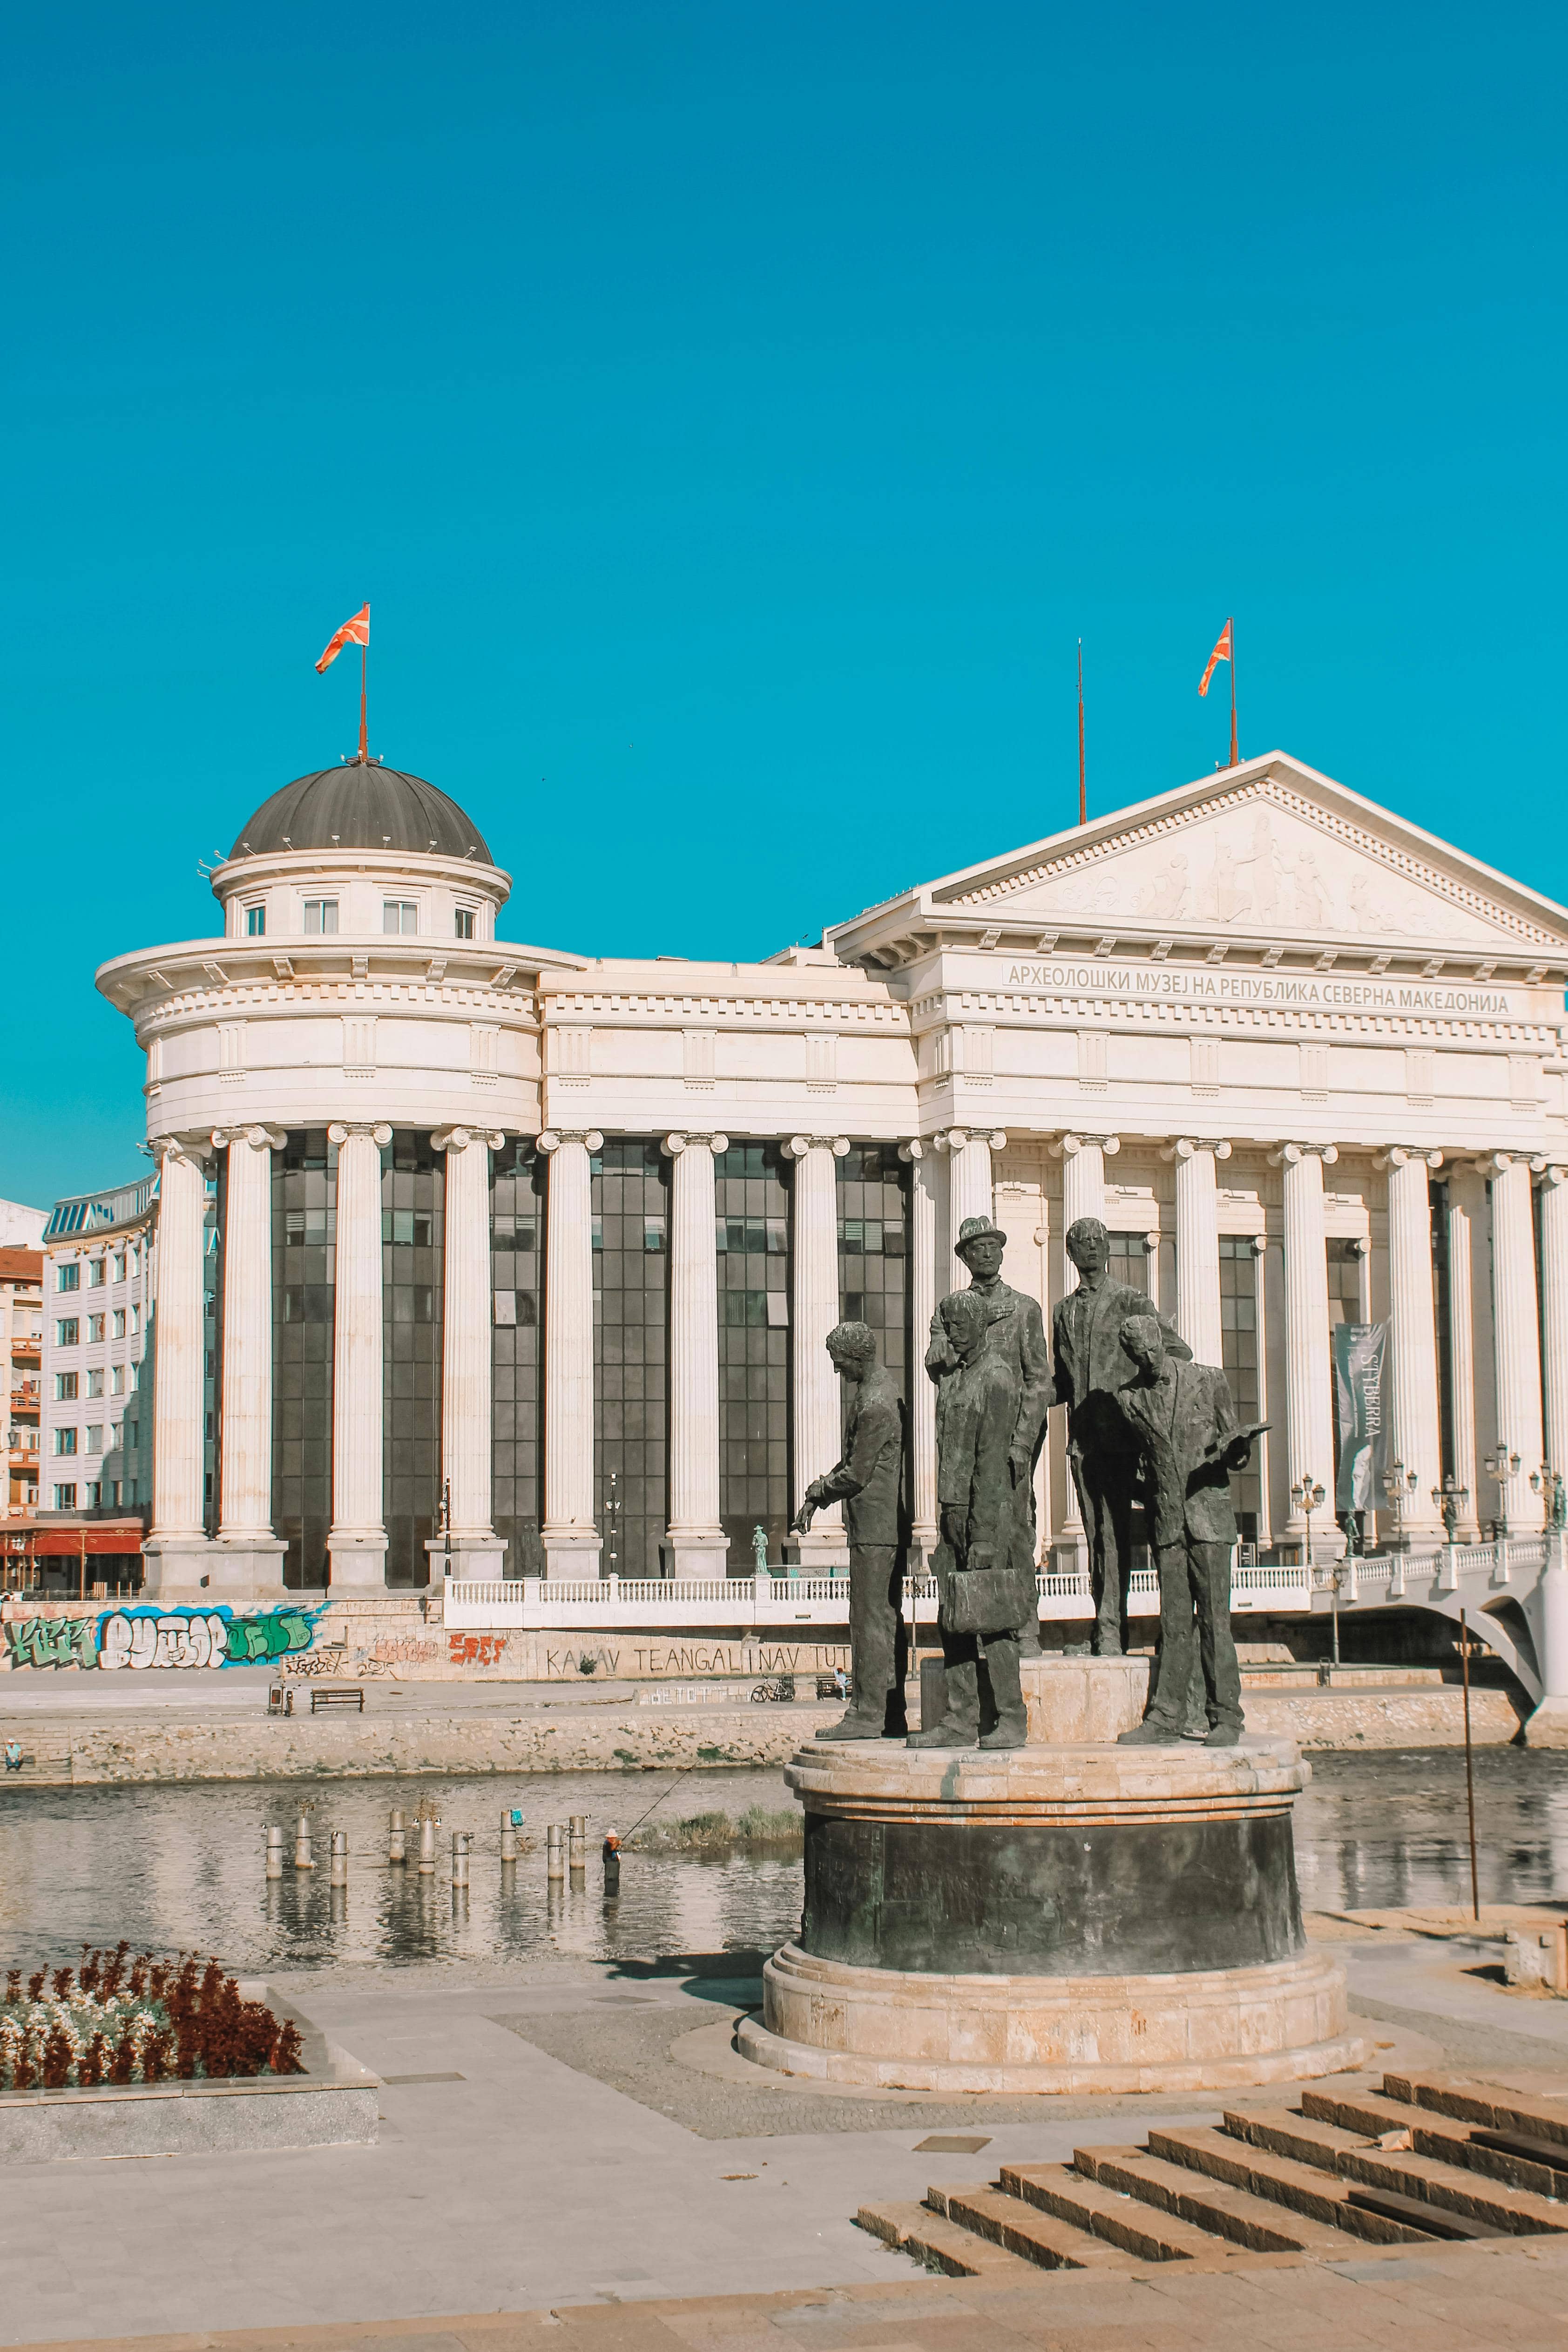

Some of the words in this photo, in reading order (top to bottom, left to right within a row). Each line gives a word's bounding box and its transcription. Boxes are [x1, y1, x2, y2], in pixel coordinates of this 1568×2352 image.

[1008, 965, 1130, 990] АРХЕОЛОШКИ
[1136, 972, 1189, 994] МУЗЕЈ
[1193, 976, 1217, 995] НА
[1220, 978, 1318, 1002] РЕПУБЛИКА
[1322, 984, 1396, 1007] СЕВЕРНА
[1399, 990, 1509, 1013] МАКЕДОНИЈА
[1360, 1354, 1381, 1438] STYBERRA
[810, 1646, 851, 1670] TUT
